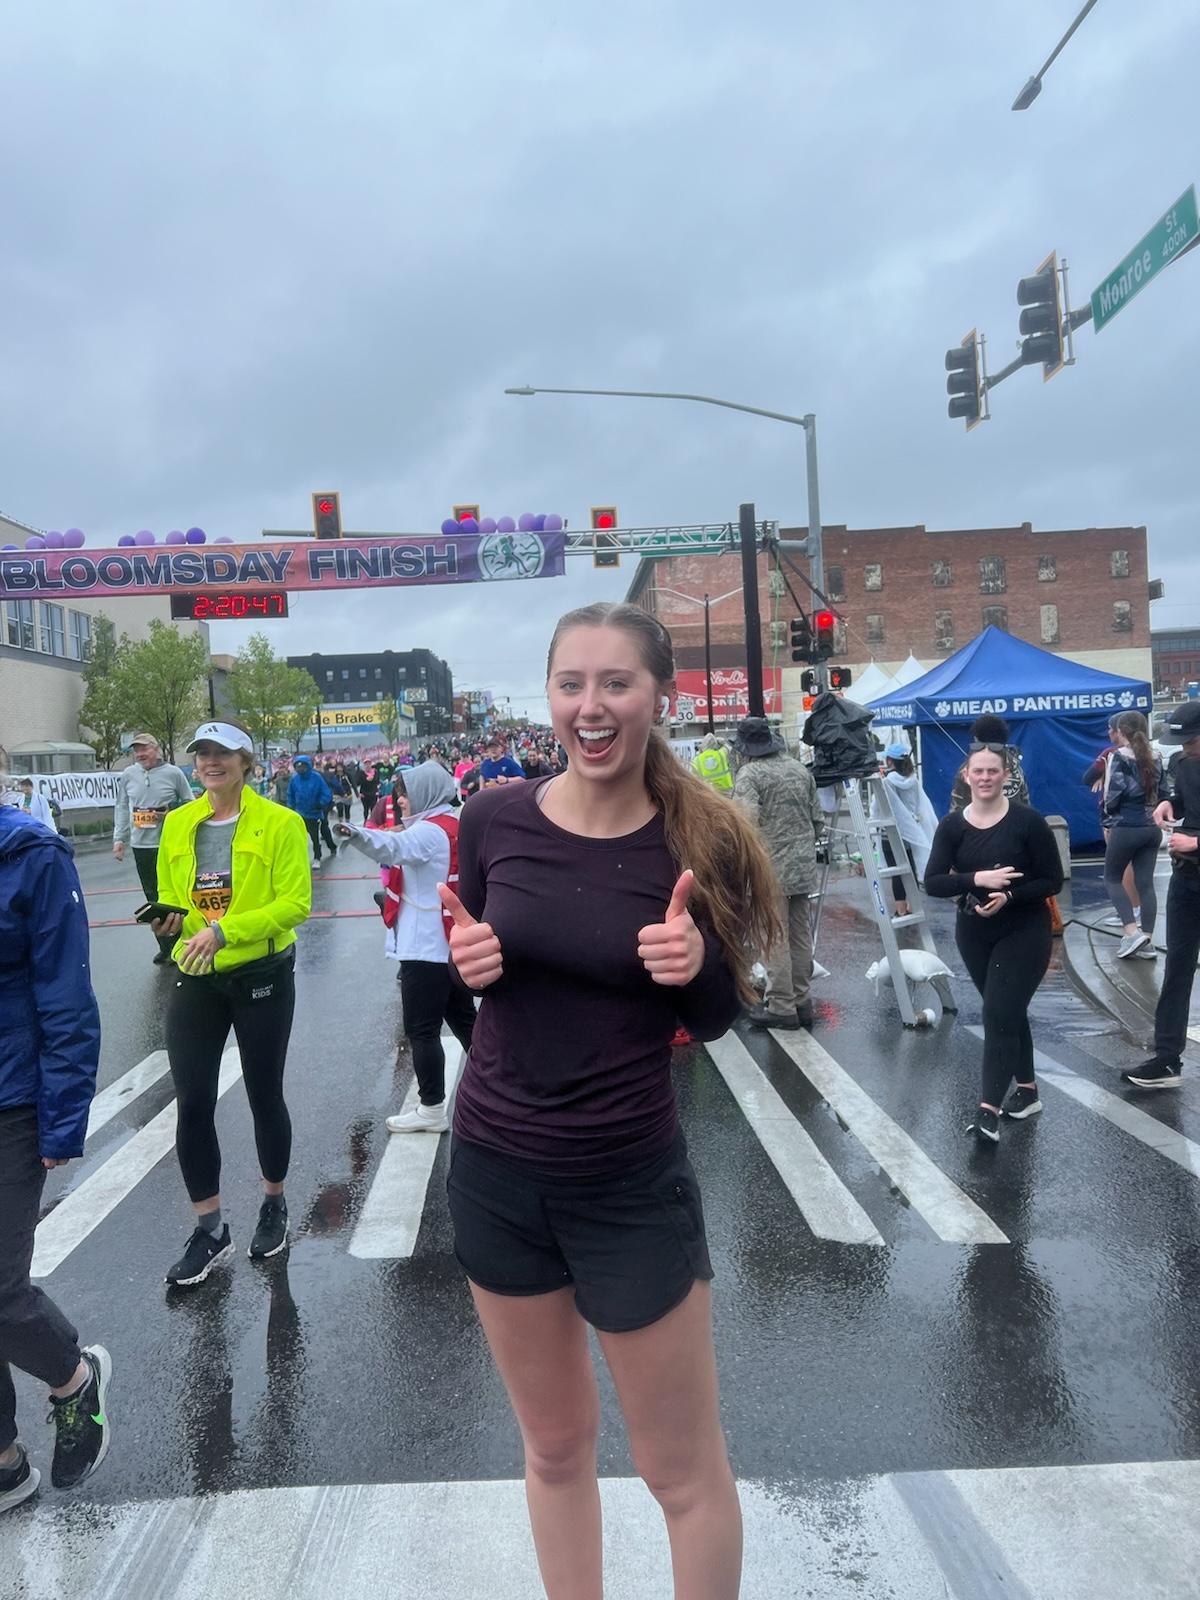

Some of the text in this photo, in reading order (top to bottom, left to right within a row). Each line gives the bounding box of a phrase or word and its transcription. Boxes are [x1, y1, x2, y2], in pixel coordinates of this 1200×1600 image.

[1165, 210, 1178, 233] St
[1162, 224, 1188, 257] 400N
[1100, 249, 1152, 317] Monroe
[1, 544, 458, 592] BLOOMSDAY FINISH
[952, 693, 1116, 715] MEAD PANTHERS
[335, 713, 374, 725] Brake
[678, 711, 693, 720] 30
[194, 895, 231, 910] 465
[252, 989, 272, 1000] KIDS
